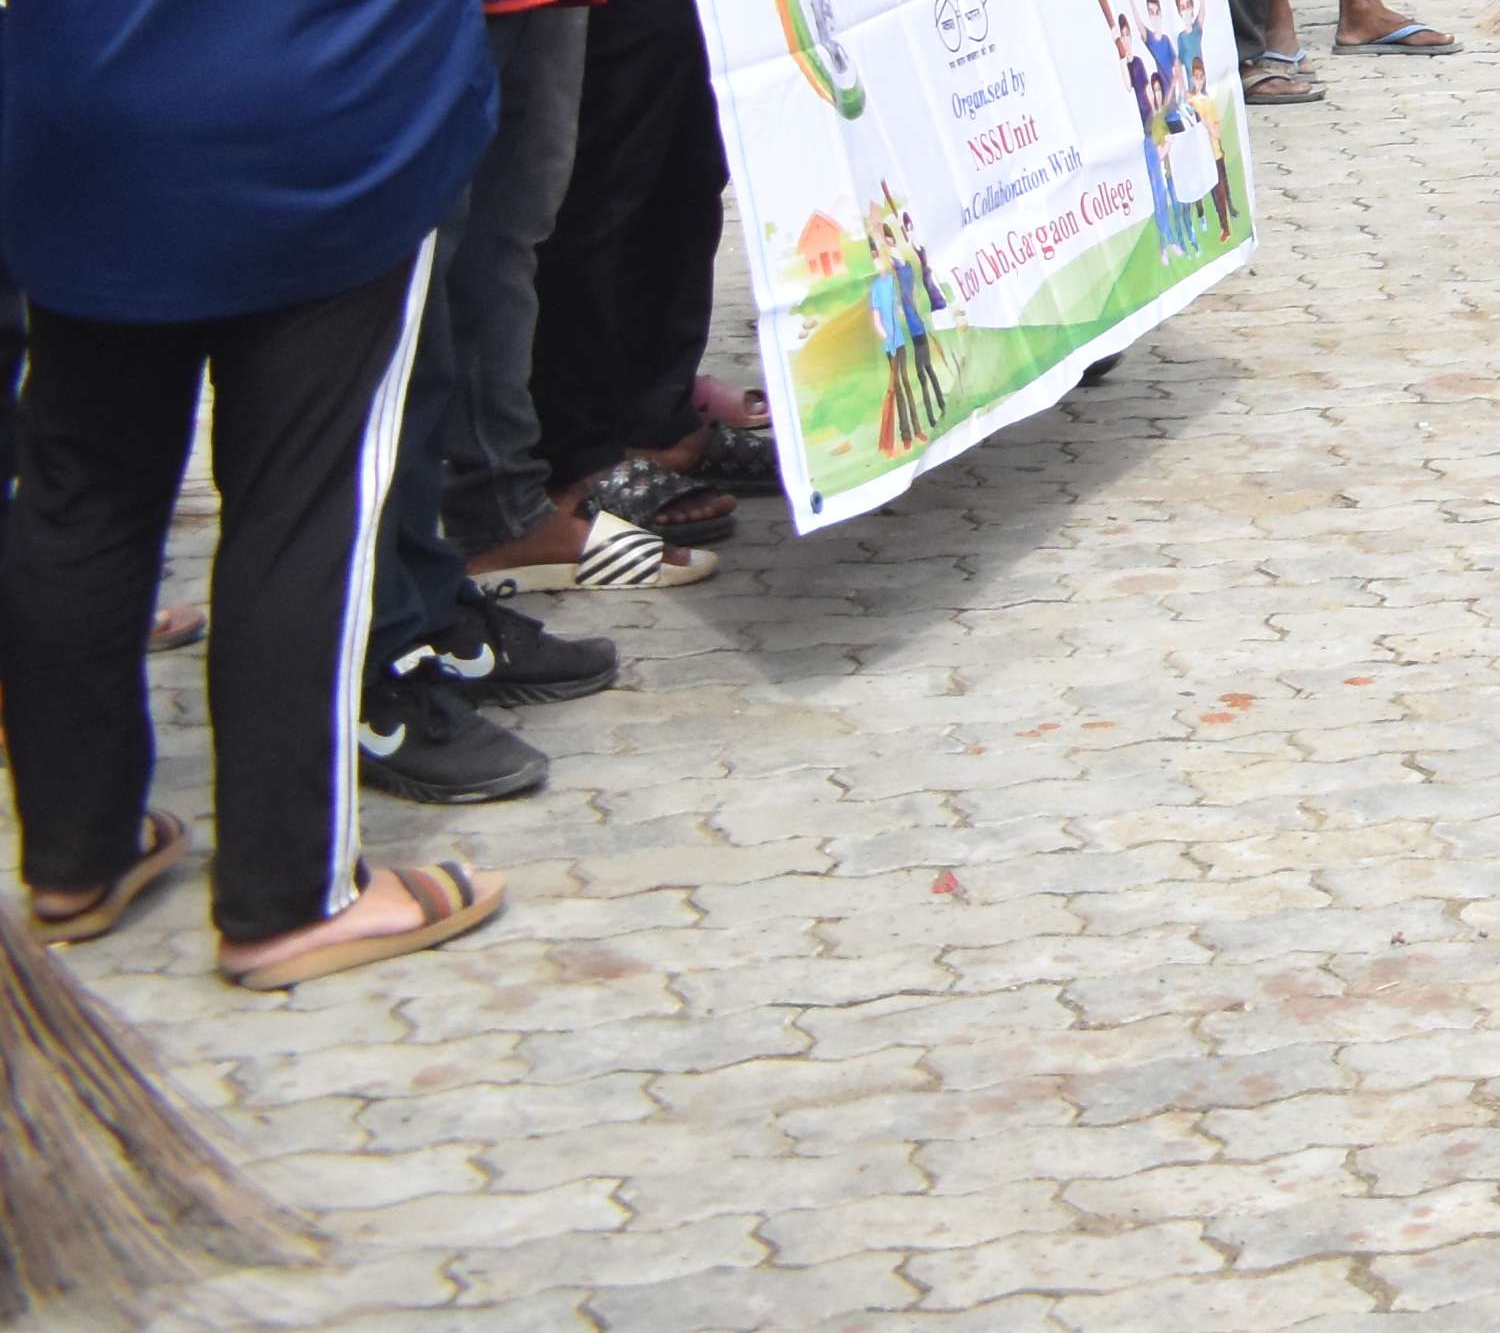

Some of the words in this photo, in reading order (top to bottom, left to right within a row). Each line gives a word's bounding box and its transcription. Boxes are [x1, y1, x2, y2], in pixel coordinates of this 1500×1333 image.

[951, 70, 1009, 120] Organsed
[1010, 67, 1026, 97] by
[972, 167, 1050, 221] Collaboration
[1047, 145, 1083, 178] With
[950, 266, 981, 303] Eco
[1080, 178, 1135, 226] College
